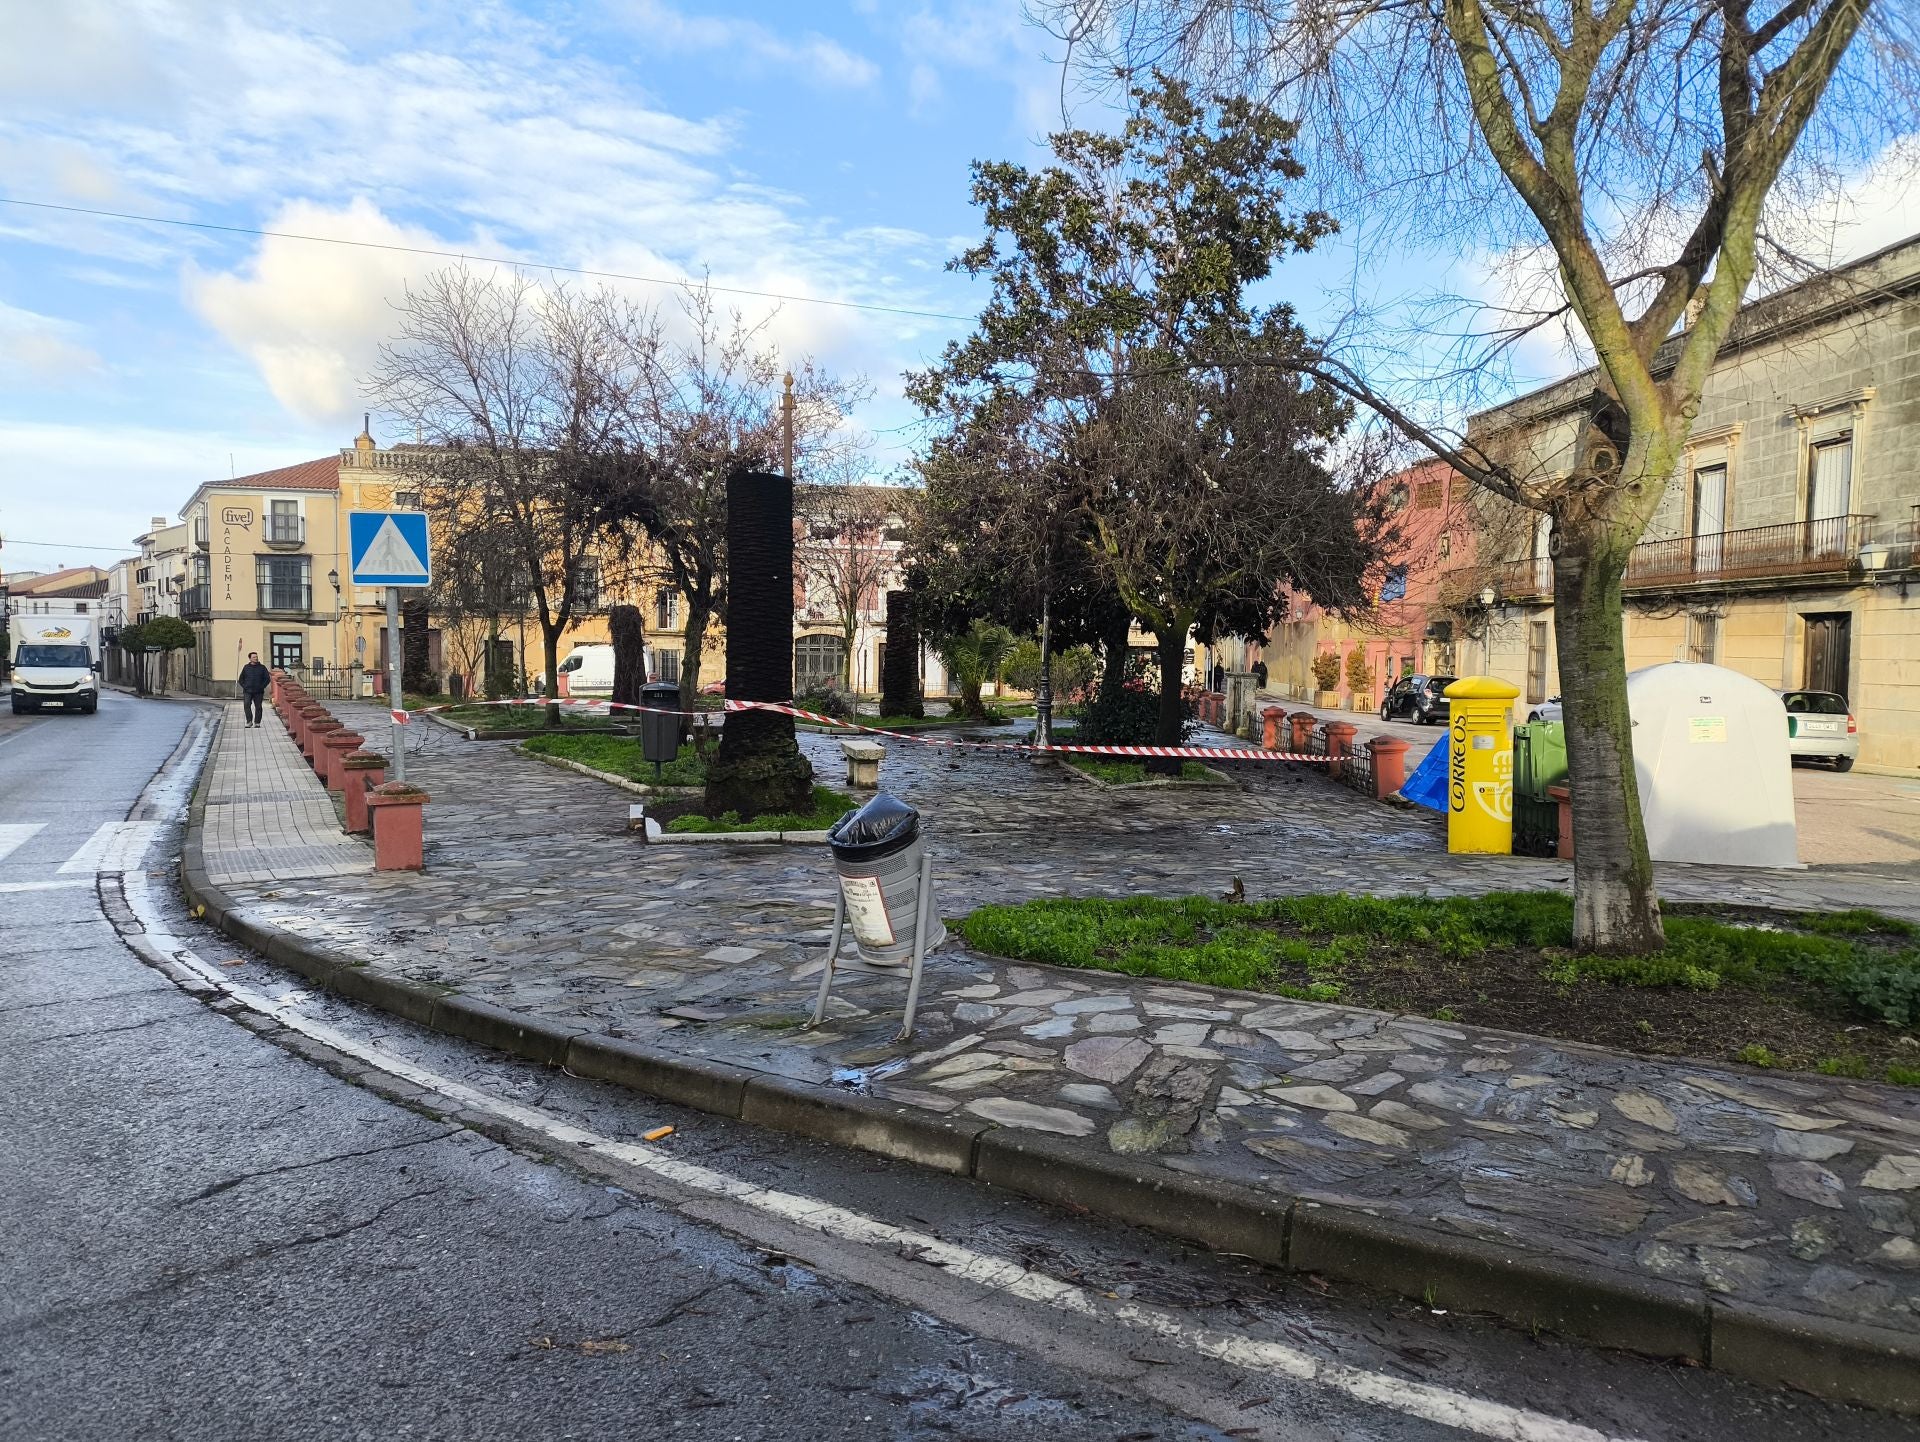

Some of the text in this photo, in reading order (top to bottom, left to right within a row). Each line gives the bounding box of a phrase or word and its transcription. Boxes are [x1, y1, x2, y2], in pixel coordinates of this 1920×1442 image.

[225, 510, 250, 522] five!
[224, 528, 232, 600] ACADEMIA
[1451, 714, 1466, 813] CORREOS
